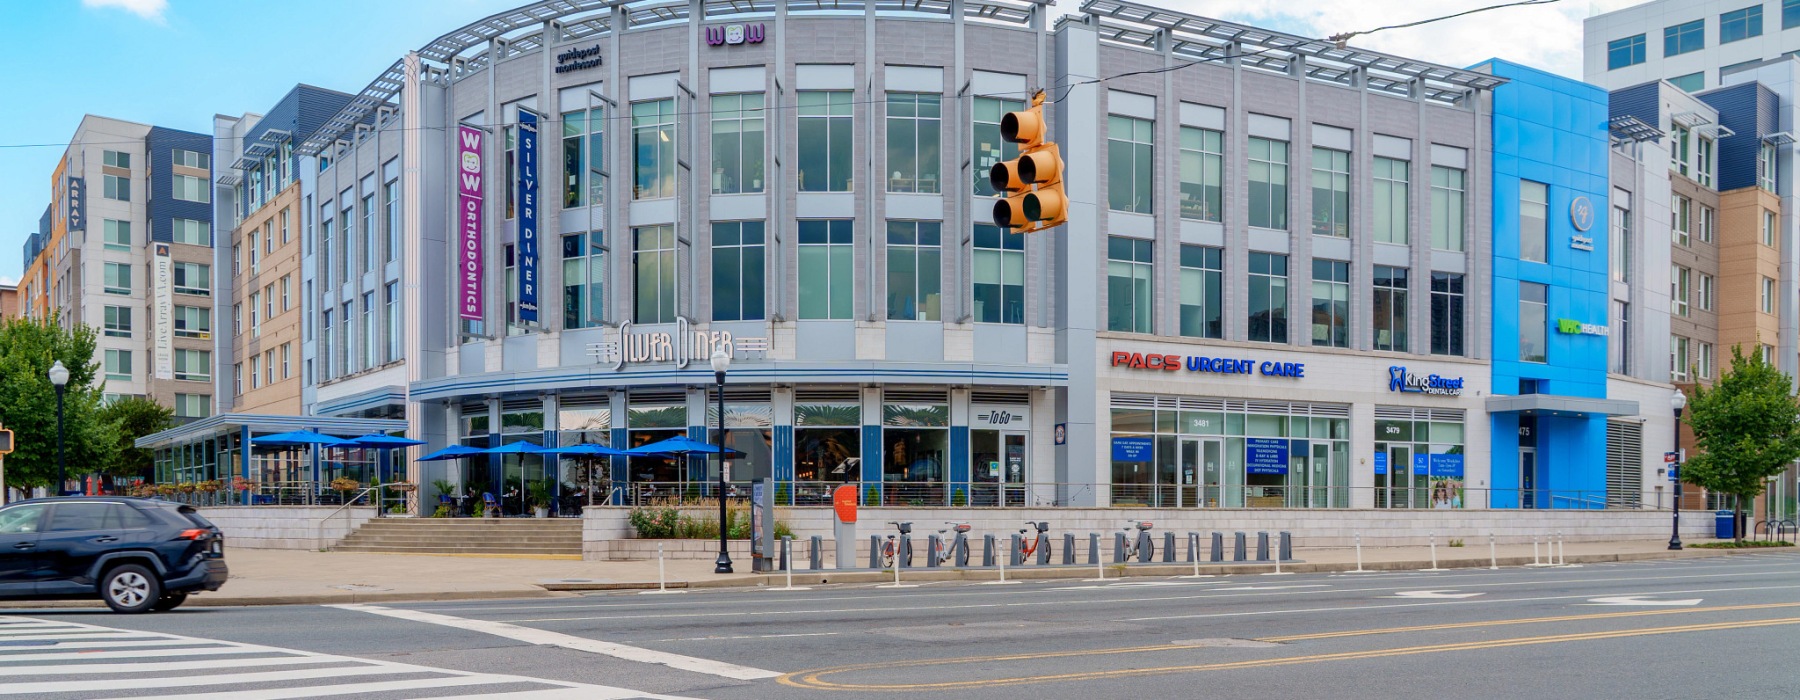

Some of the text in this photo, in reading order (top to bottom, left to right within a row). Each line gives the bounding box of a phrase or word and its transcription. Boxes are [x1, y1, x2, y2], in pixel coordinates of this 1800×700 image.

[557, 44, 600, 64] guidepost
[555, 56, 602, 74] montessori
[525, 138, 533, 219] SILVER
[71, 180, 80, 227] ARRAY
[467, 200, 477, 313] ORTHODONTICS
[525, 228, 533, 296] DINER
[1557, 318, 1610, 336] VHC HEALTH
[1112, 351, 1305, 378] PACS URGENT CARE
[1428, 387, 1448, 395] DENTAL
[1193, 419, 1210, 428] 3481
[1386, 426, 1400, 435] 3479
